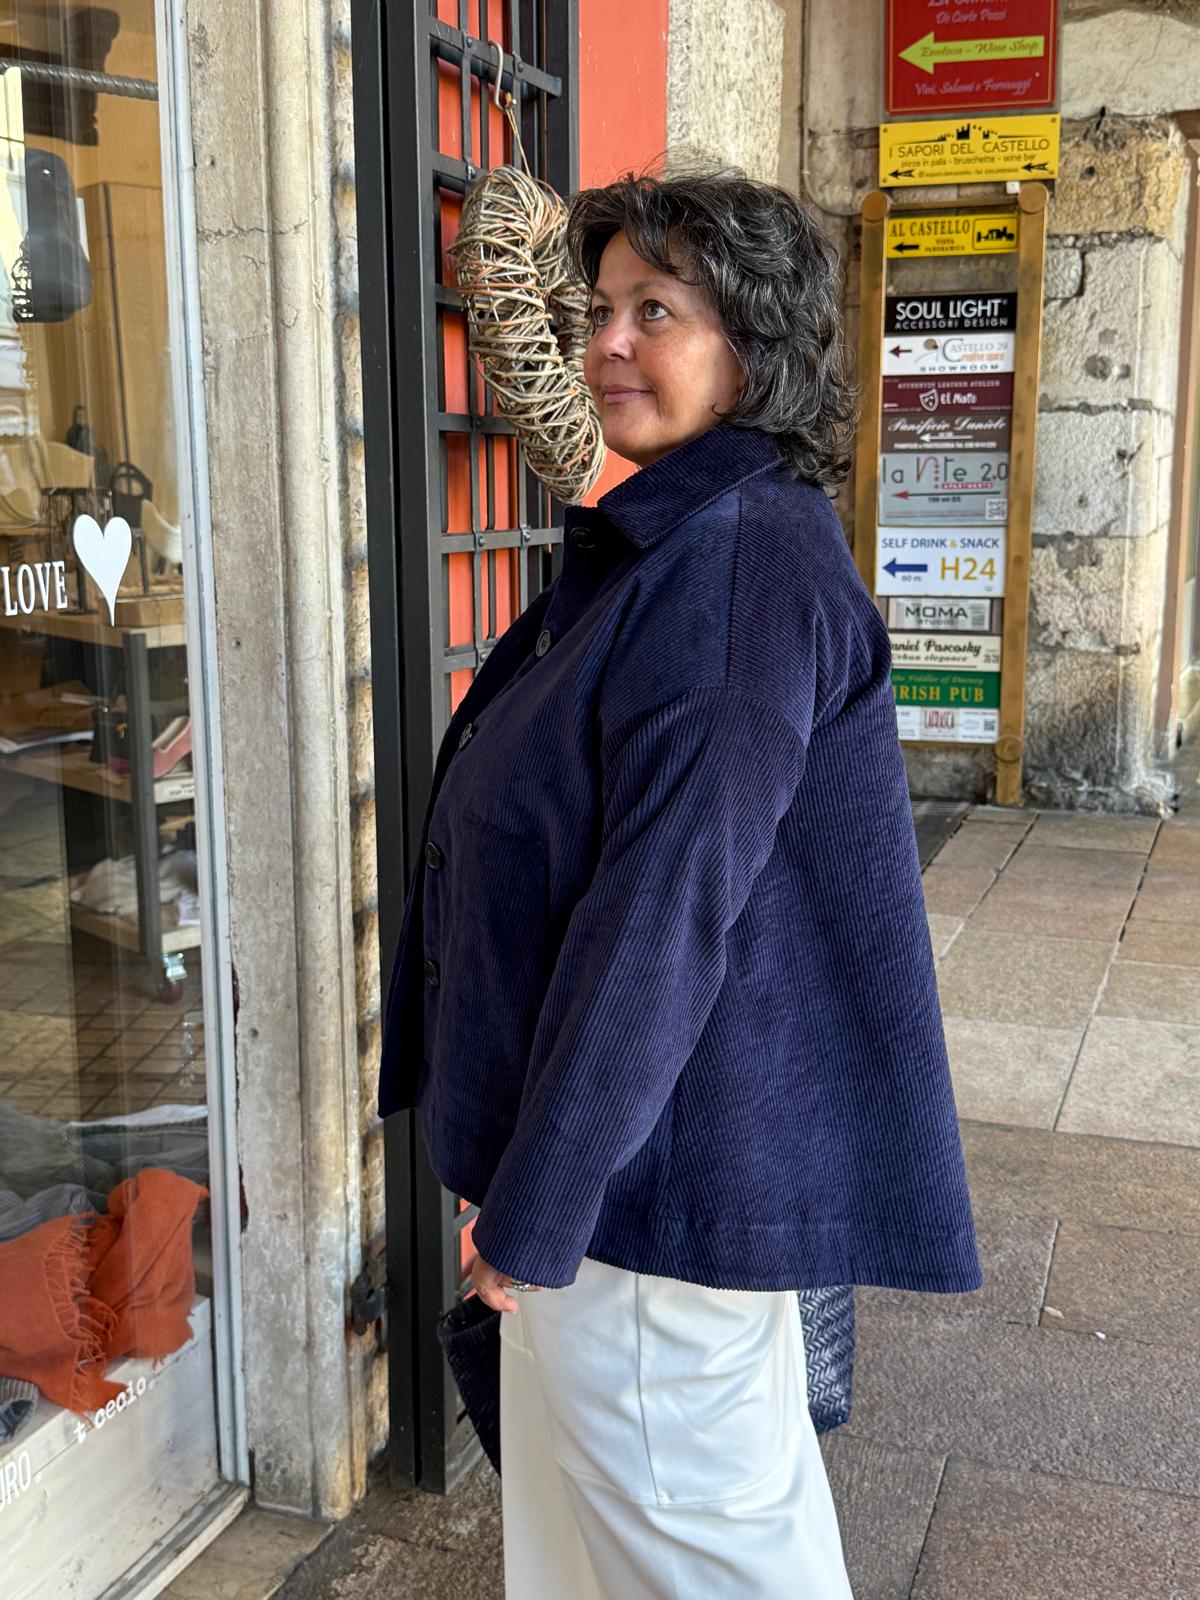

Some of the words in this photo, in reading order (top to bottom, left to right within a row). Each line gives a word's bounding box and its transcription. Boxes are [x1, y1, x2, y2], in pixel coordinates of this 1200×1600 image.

[898, 144, 944, 158] SAPORI
[950, 142, 974, 154] DEL
[982, 138, 1049, 153] CASTELLO
[901, 160, 921, 168] pizza
[931, 158, 947, 168] pala
[954, 154, 995, 166] bruschette
[1004, 154, 1021, 162] wine
[1024, 153, 1036, 161] bar
[890, 222, 905, 237] AL
[909, 219, 970, 236] CASTELLO
[895, 301, 944, 320] SOUL
[894, 319, 959, 330] ACCESSORI
[963, 317, 1008, 328] DESIGN
[920, 363, 999, 372] SHOWROOM
[979, 463, 1008, 481] 2.0
[882, 539, 909, 549] SELF
[911, 539, 947, 549] DRINK
[949, 540, 957, 548] &
[959, 539, 1000, 548] SNACK
[941, 557, 996, 580] H24
[1, 561, 68, 616] LOVE
[905, 607, 968, 618] MOMA
[891, 640, 920, 651] aniel
[950, 687, 984, 703] PUB
